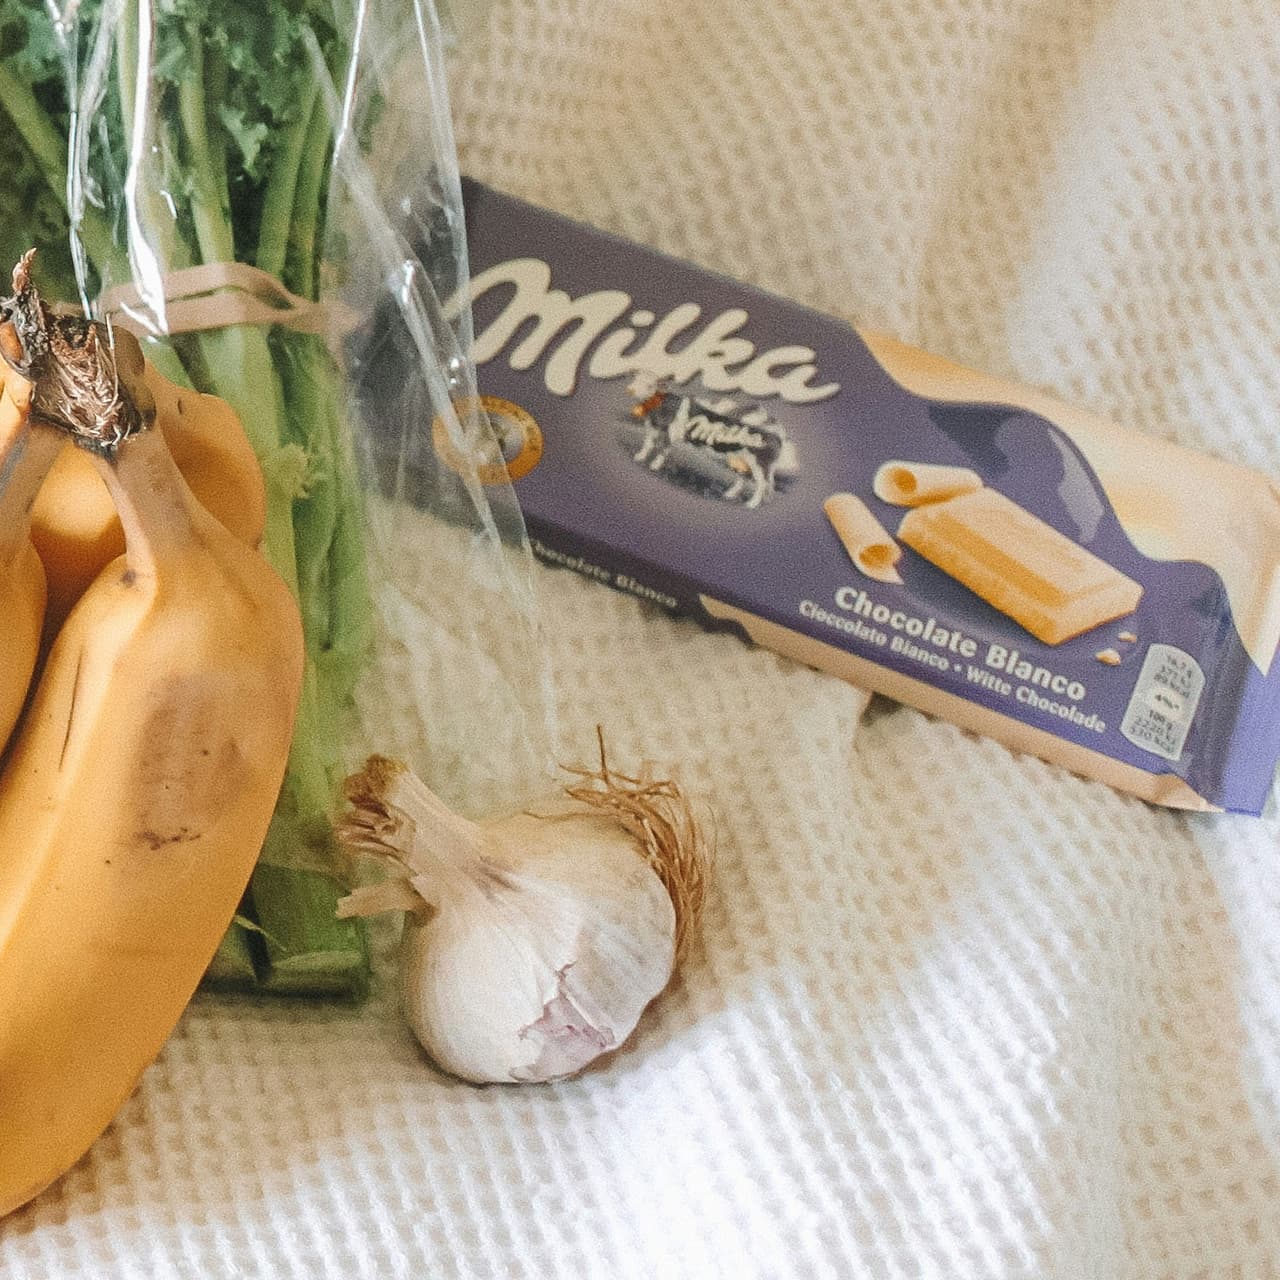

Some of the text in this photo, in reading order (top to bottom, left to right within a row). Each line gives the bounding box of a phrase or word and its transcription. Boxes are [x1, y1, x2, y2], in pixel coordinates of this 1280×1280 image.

[441, 258, 841, 404] Milka
[798, 599, 950, 672] Cioccolato Bianco
[834, 585, 1088, 703] Chocolate Blanco
[966, 665, 1107, 734] Witte Chocolade
